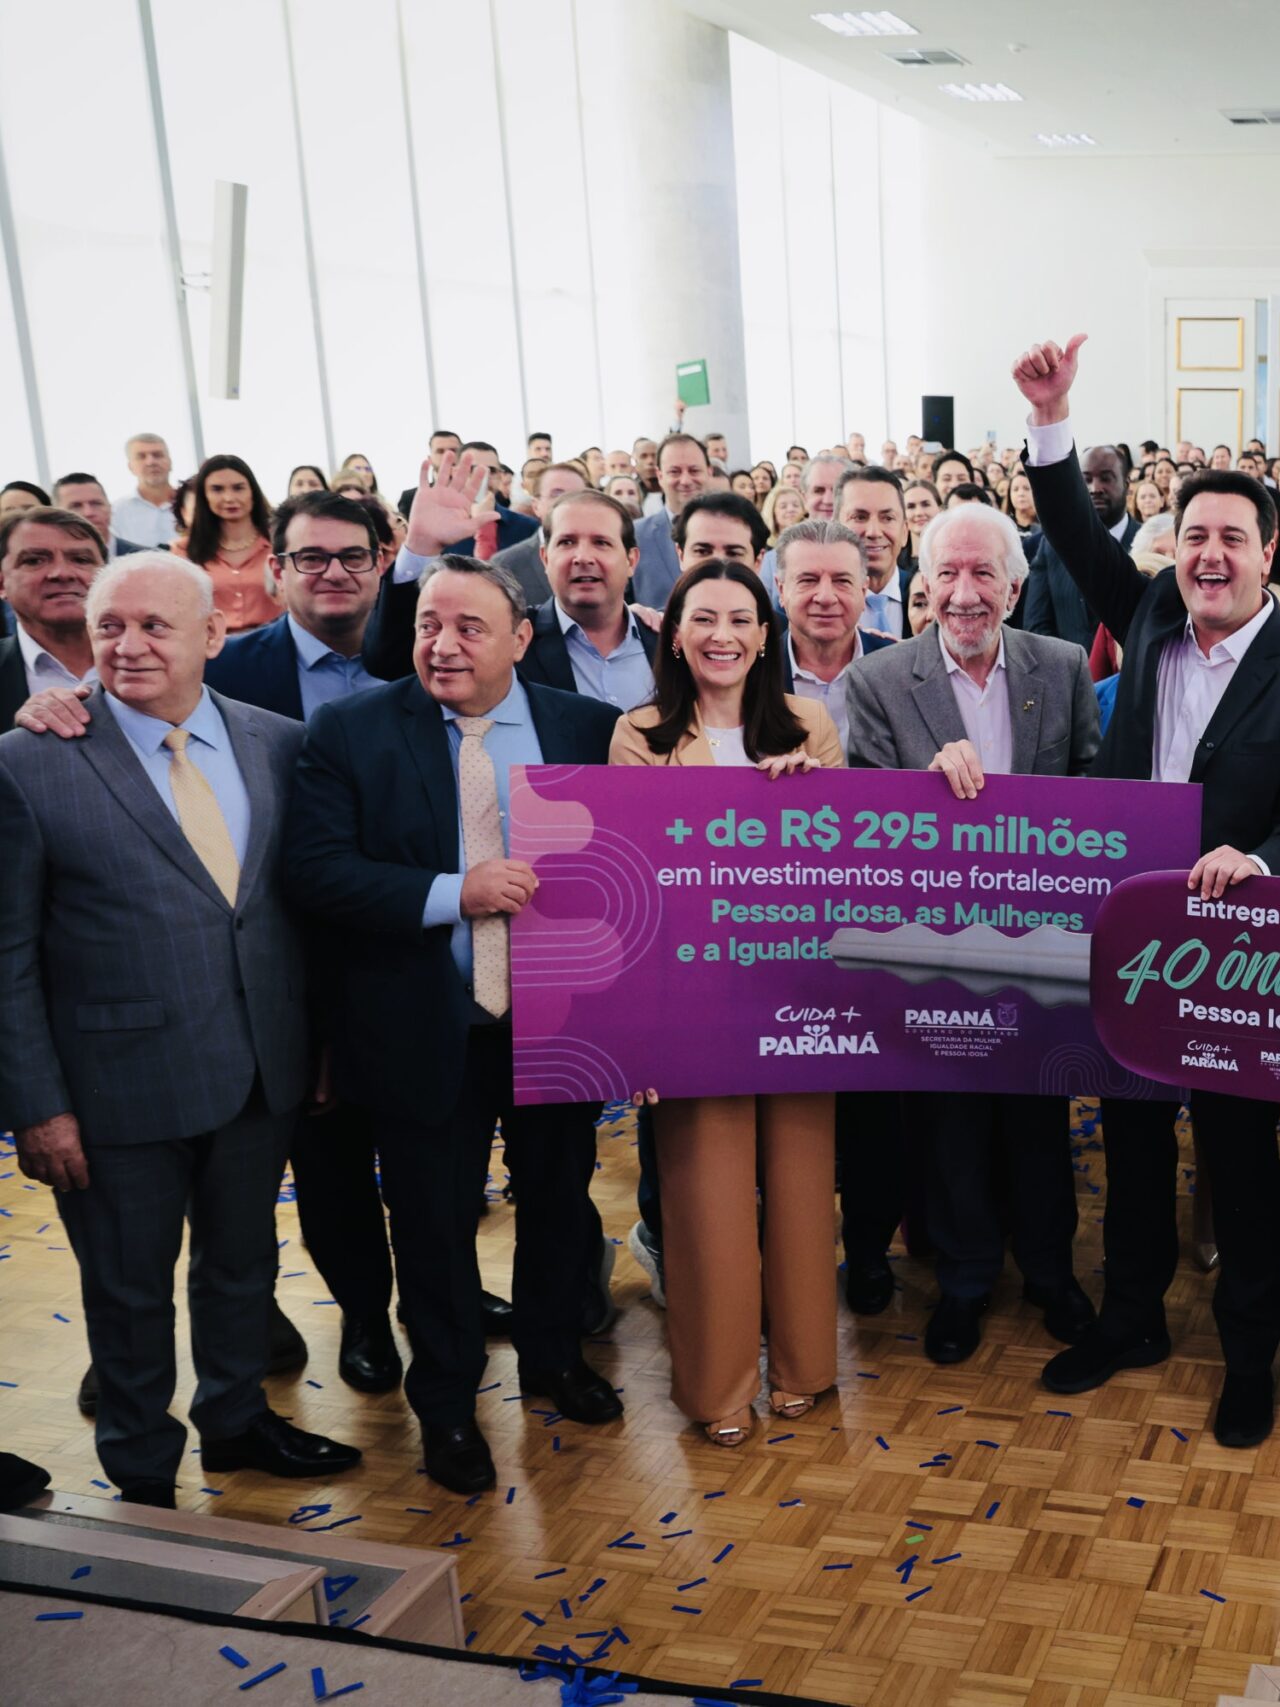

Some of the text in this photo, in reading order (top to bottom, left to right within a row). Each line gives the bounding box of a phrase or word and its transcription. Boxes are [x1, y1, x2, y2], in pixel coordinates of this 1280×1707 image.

[666, 805, 1127, 859] + de R$ 295 milhões
[657, 861, 1111, 895] em investimentos que fortalecem
[712, 899, 1083, 931] Pessoa Idosa, as Mulheres
[1187, 896, 1280, 927] Entrega
[677, 936, 834, 966] e a Igualda
[1117, 938, 1210, 1005] 40
[775, 1006, 861, 1023] CUIDA +
[905, 1009, 995, 1026] PARANÁ
[1179, 999, 1260, 1026] Pessoa
[759, 1032, 880, 1056] PARANÁ
[1187, 1040, 1219, 1053] CUIDA
[1181, 1055, 1239, 1072] PARANÁ
